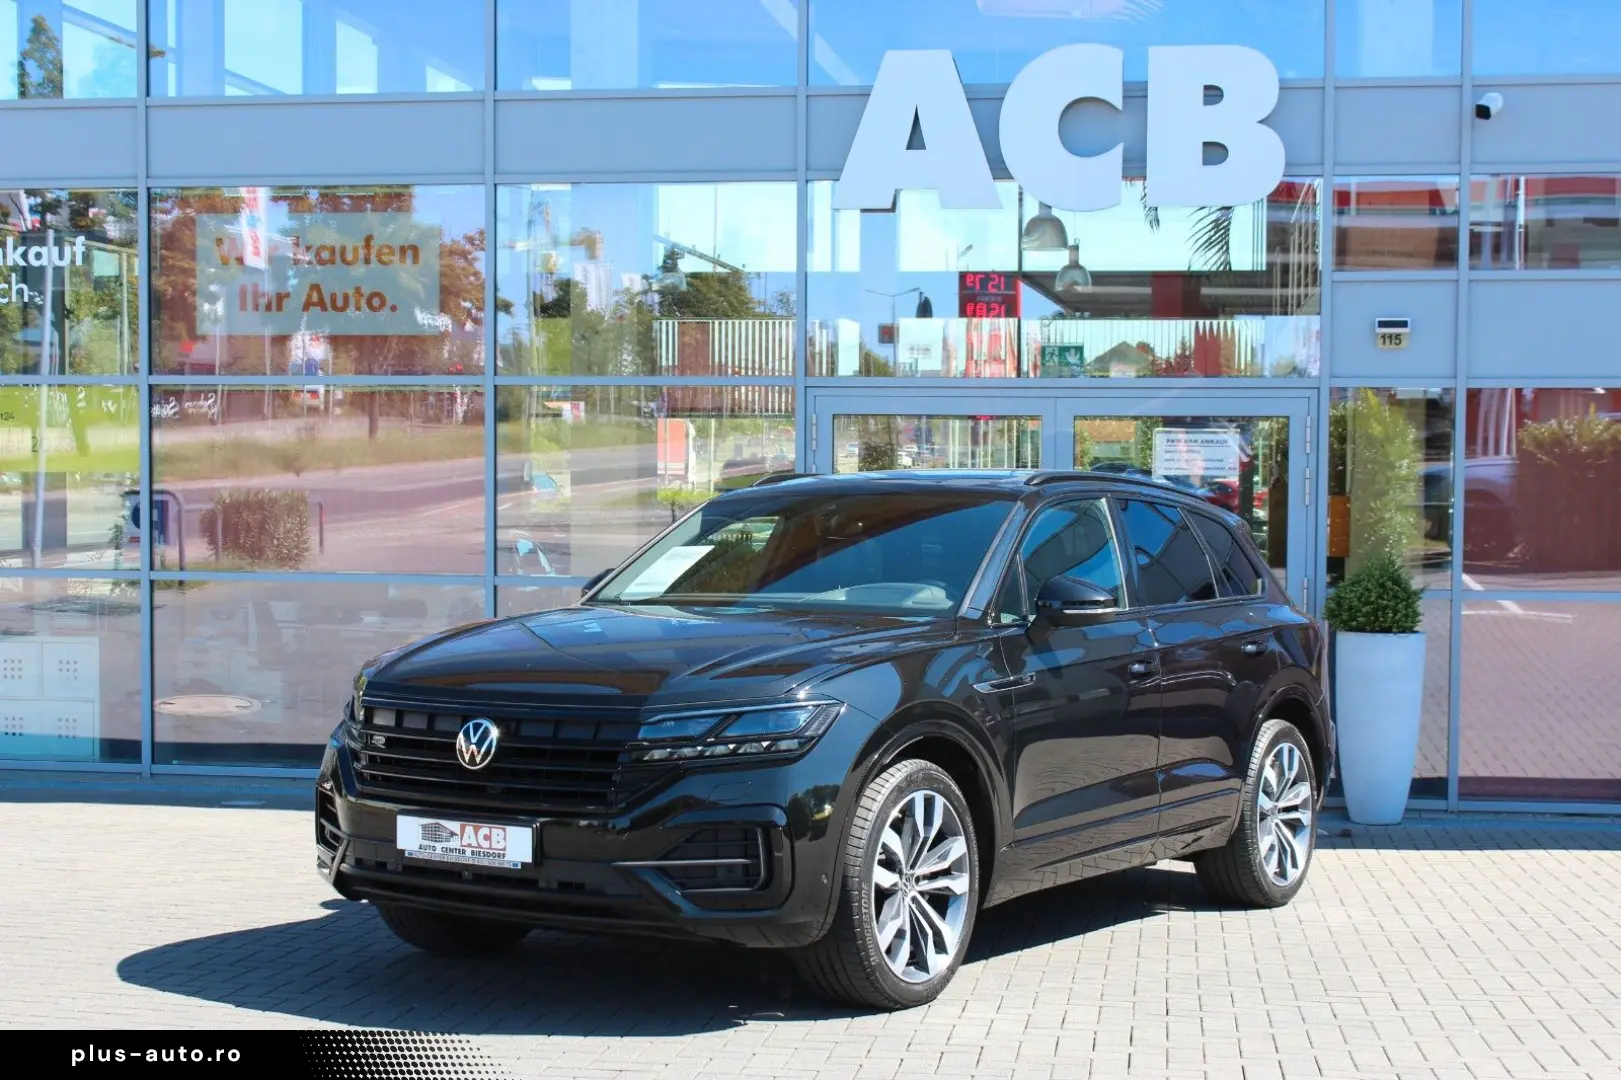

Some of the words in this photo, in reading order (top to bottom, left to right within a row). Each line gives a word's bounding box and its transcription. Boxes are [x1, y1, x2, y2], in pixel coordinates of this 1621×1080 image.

[832, 43, 1286, 211] ACB
[0, 235, 86, 267] kauf
[292, 234, 420, 267] kaufen
[238, 283, 291, 312] Ihr
[302, 283, 398, 312] Auto.
[1380, 334, 1402, 346] 115
[418, 843, 437, 853] AUTO
[441, 846, 467, 856] CENTER
[470, 849, 507, 860] BIESDORF
[461, 825, 506, 850] ACB
[861, 882, 878, 966] BRIDGESTONE
